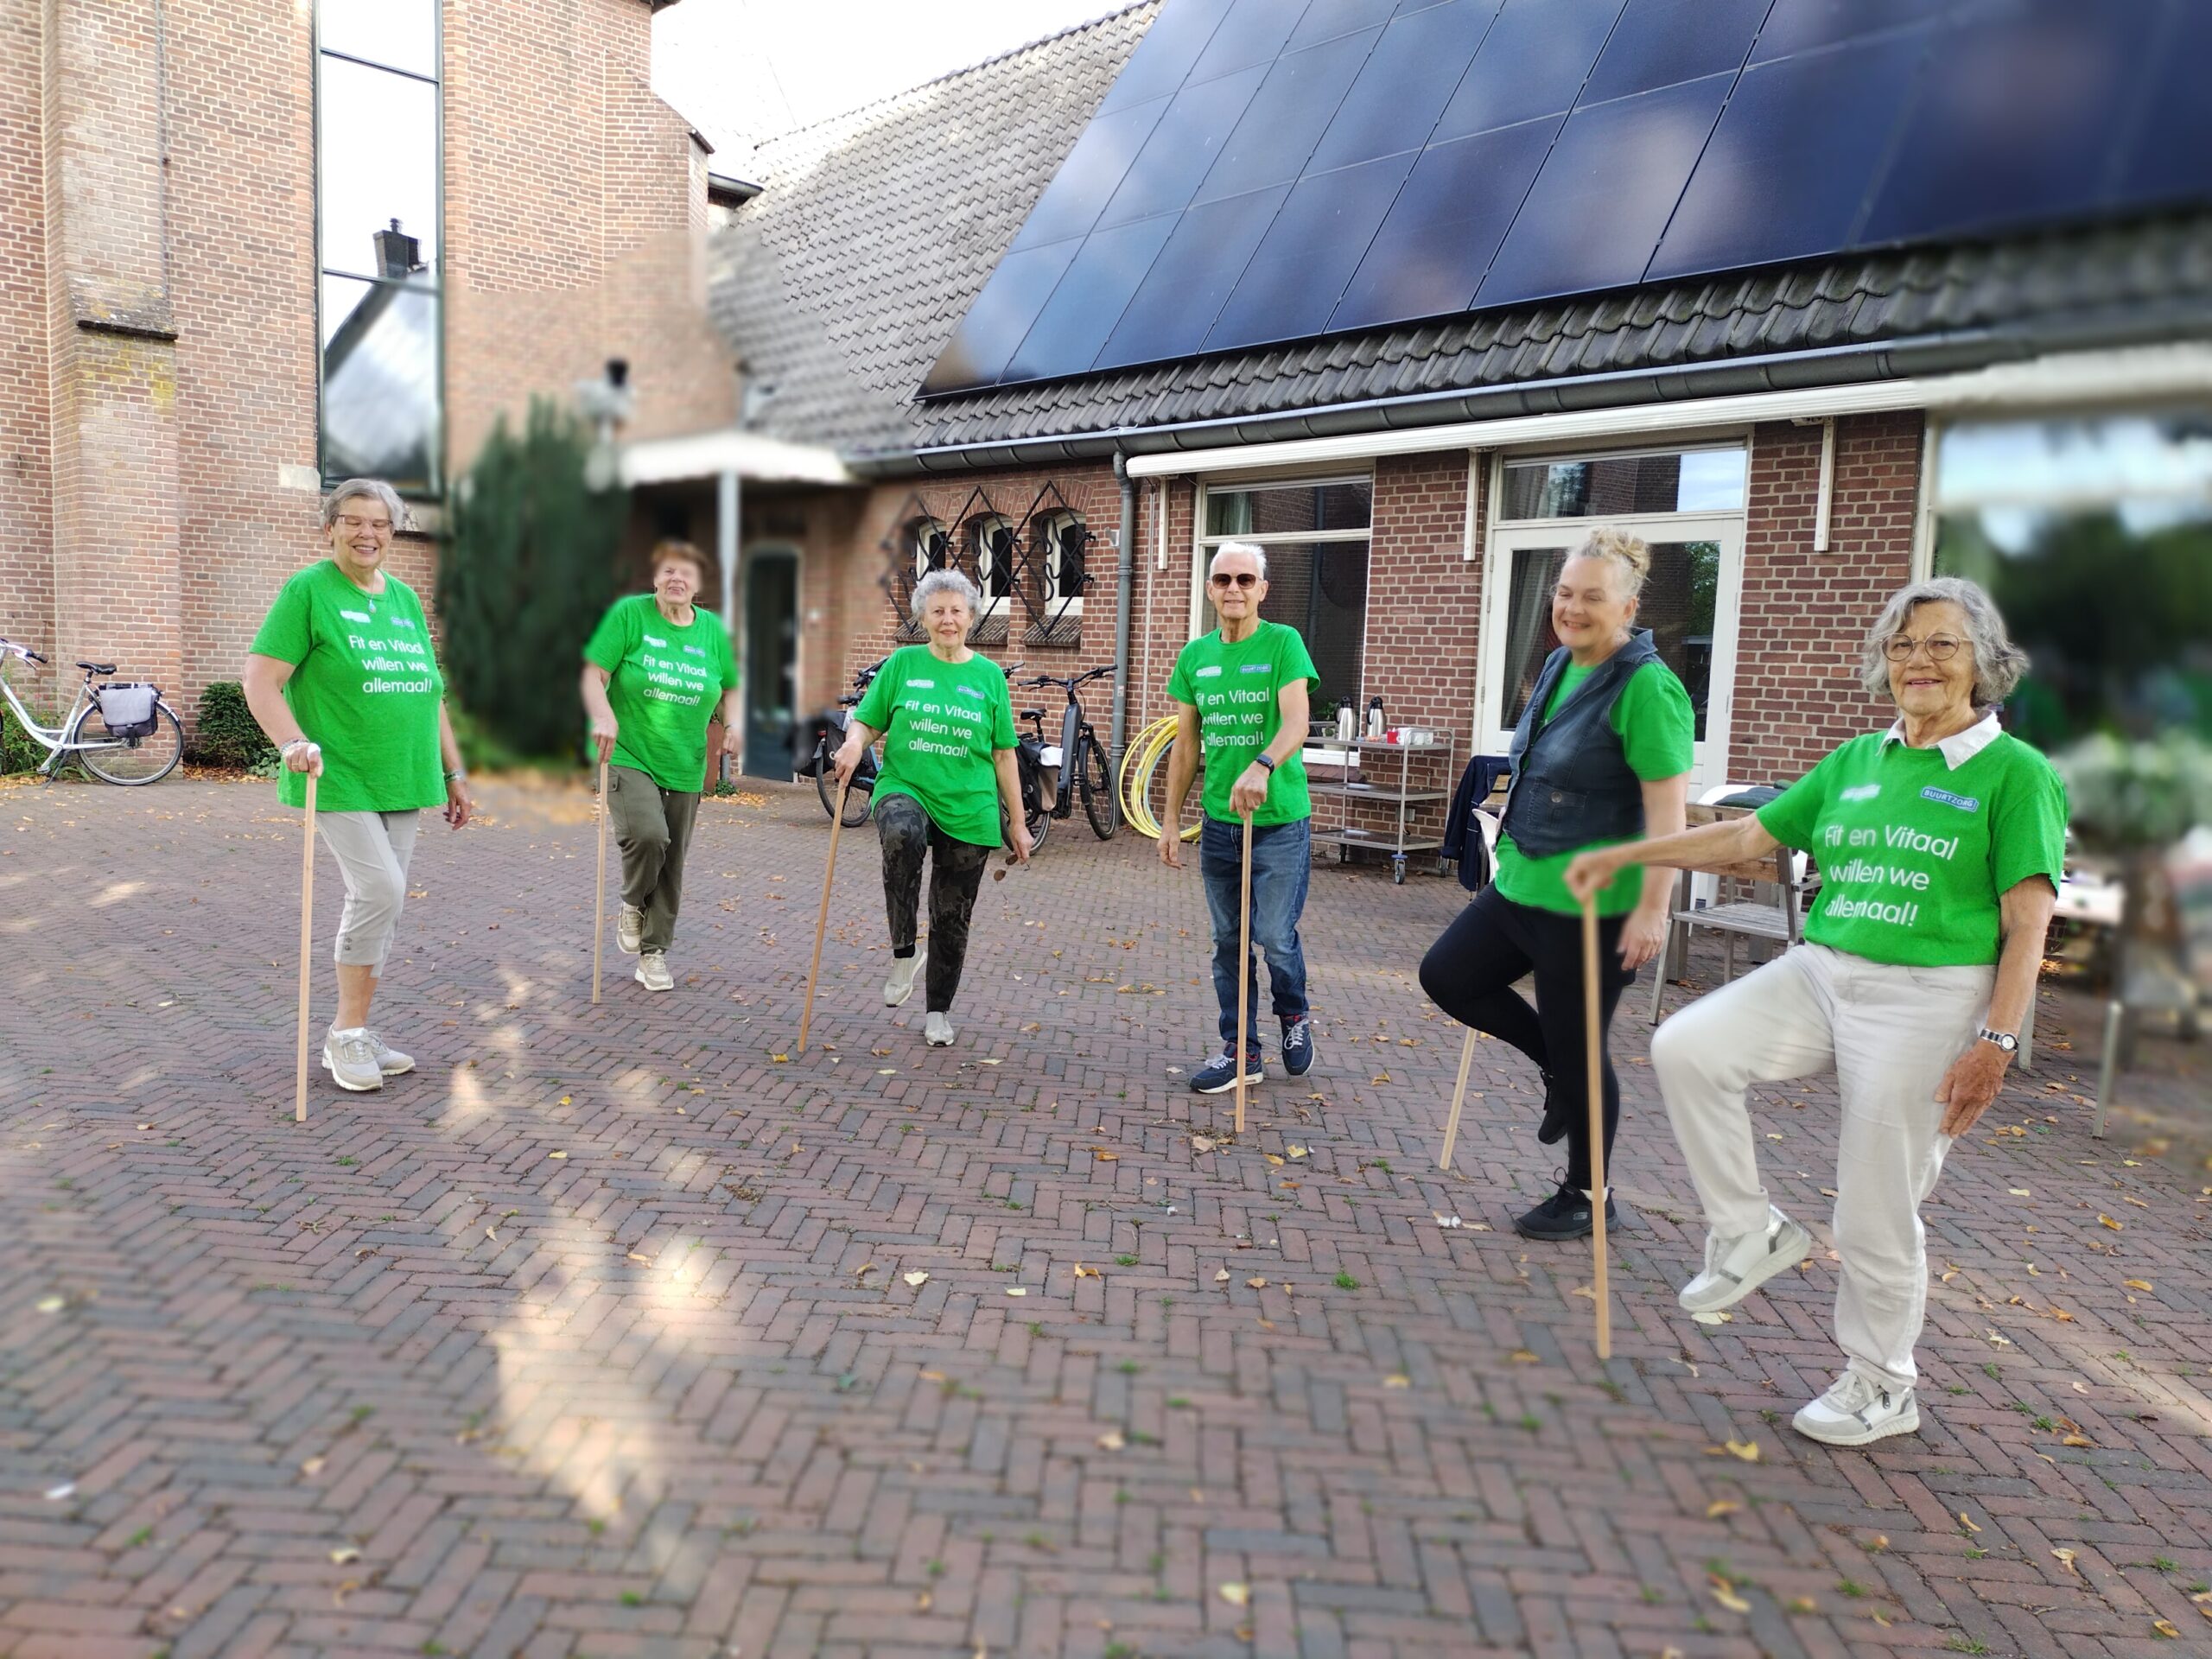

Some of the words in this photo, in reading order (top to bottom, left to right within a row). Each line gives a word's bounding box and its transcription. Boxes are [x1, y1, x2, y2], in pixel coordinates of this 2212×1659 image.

[348, 634, 365, 649] Fit
[368, 639, 387, 652] en
[387, 638, 425, 655] Vitaal
[361, 656, 404, 671] willen
[406, 660, 429, 672] we
[643, 654, 656, 668] Fit
[658, 659, 674, 671] en
[676, 661, 708, 677] Vitaal
[362, 677, 433, 693] allemaal!
[647, 671, 683, 687] willen
[685, 680, 704, 691] we
[643, 688, 701, 707] allemaal!
[1207, 694, 1225, 706] en
[1229, 686, 1269, 704] Vitaal
[905, 700, 920, 711] Fit
[923, 702, 940, 715] en
[944, 703, 982, 723] Vitaal
[1202, 712, 1237, 726] willen
[1241, 713, 1264, 725] we
[909, 718, 948, 734] willen
[952, 726, 972, 740] we
[908, 737, 969, 759] allemaal!
[1923, 789, 1974, 807] BUURTZORG
[1825, 824, 1844, 849] Fit
[1848, 828, 1877, 847] en
[1885, 823, 1960, 861] Vitaal
[1829, 858, 1885, 883] willen
[1890, 867, 1930, 891] we
[1824, 893, 1919, 928] allemaal!
